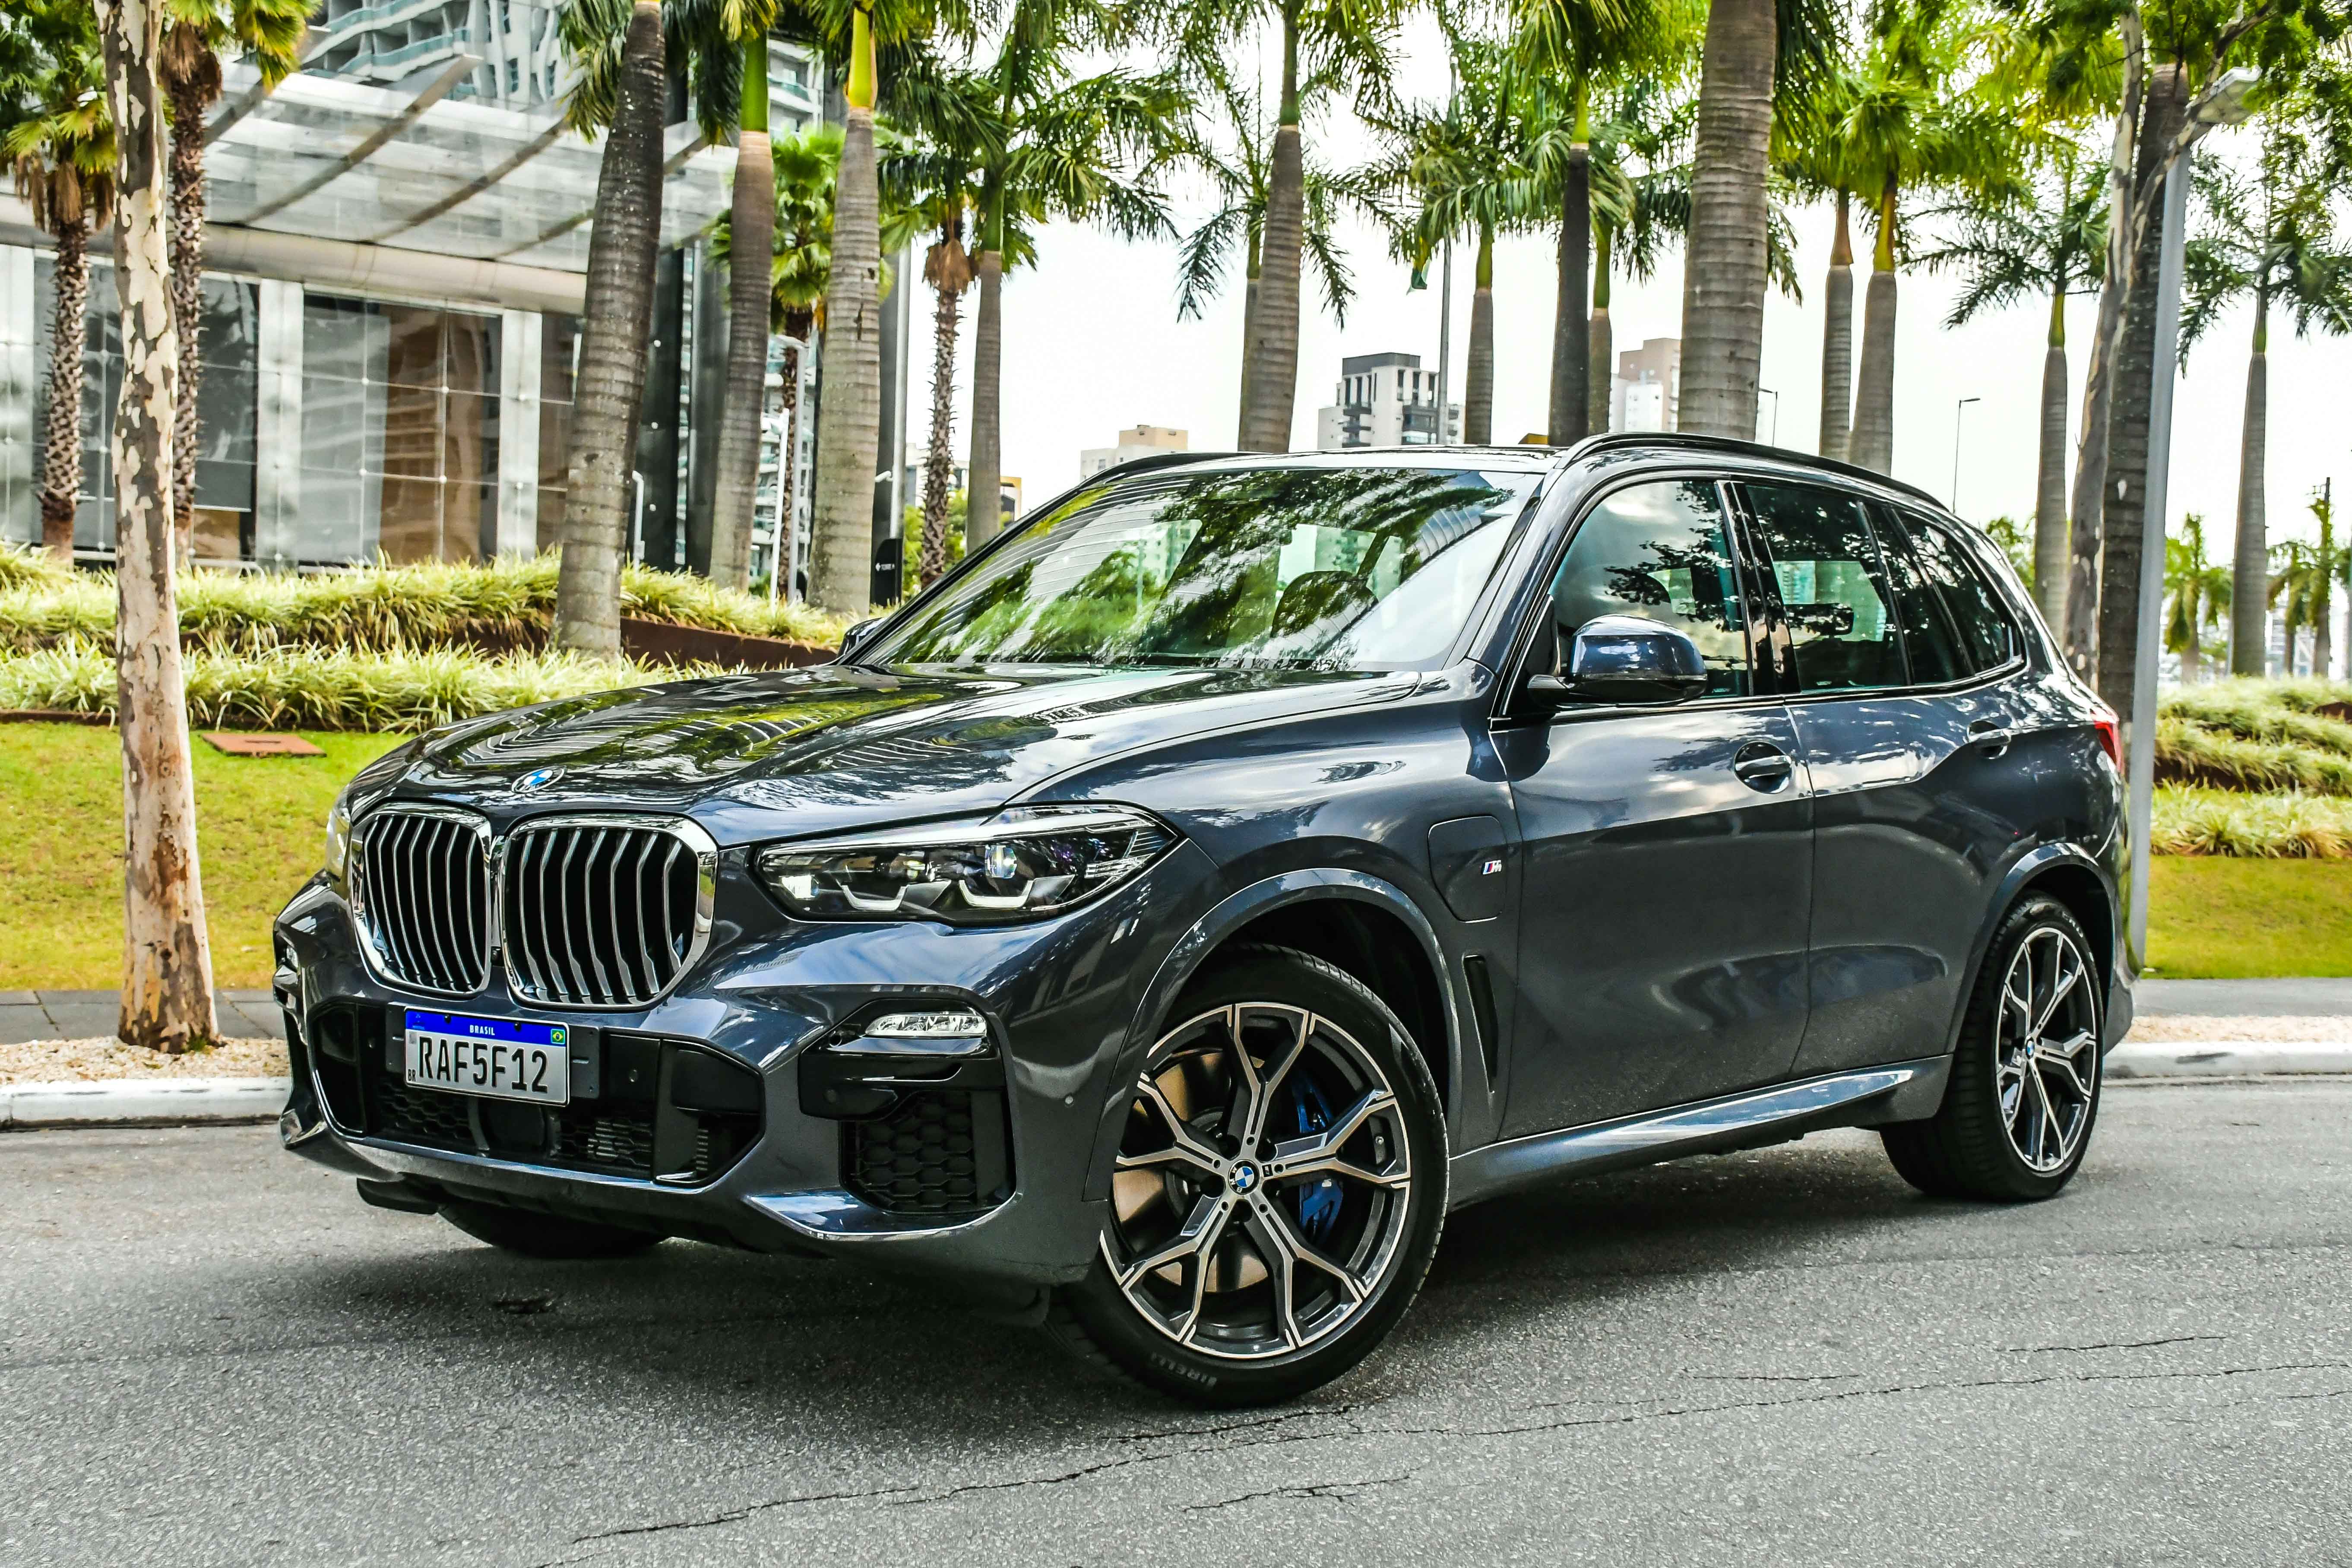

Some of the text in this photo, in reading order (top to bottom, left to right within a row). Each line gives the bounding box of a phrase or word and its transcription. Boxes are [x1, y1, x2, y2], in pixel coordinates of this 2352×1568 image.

[470, 1025, 495, 1036] BRASIL
[419, 1036, 548, 1094] RAF5F12
[408, 1069, 416, 1082] BR
